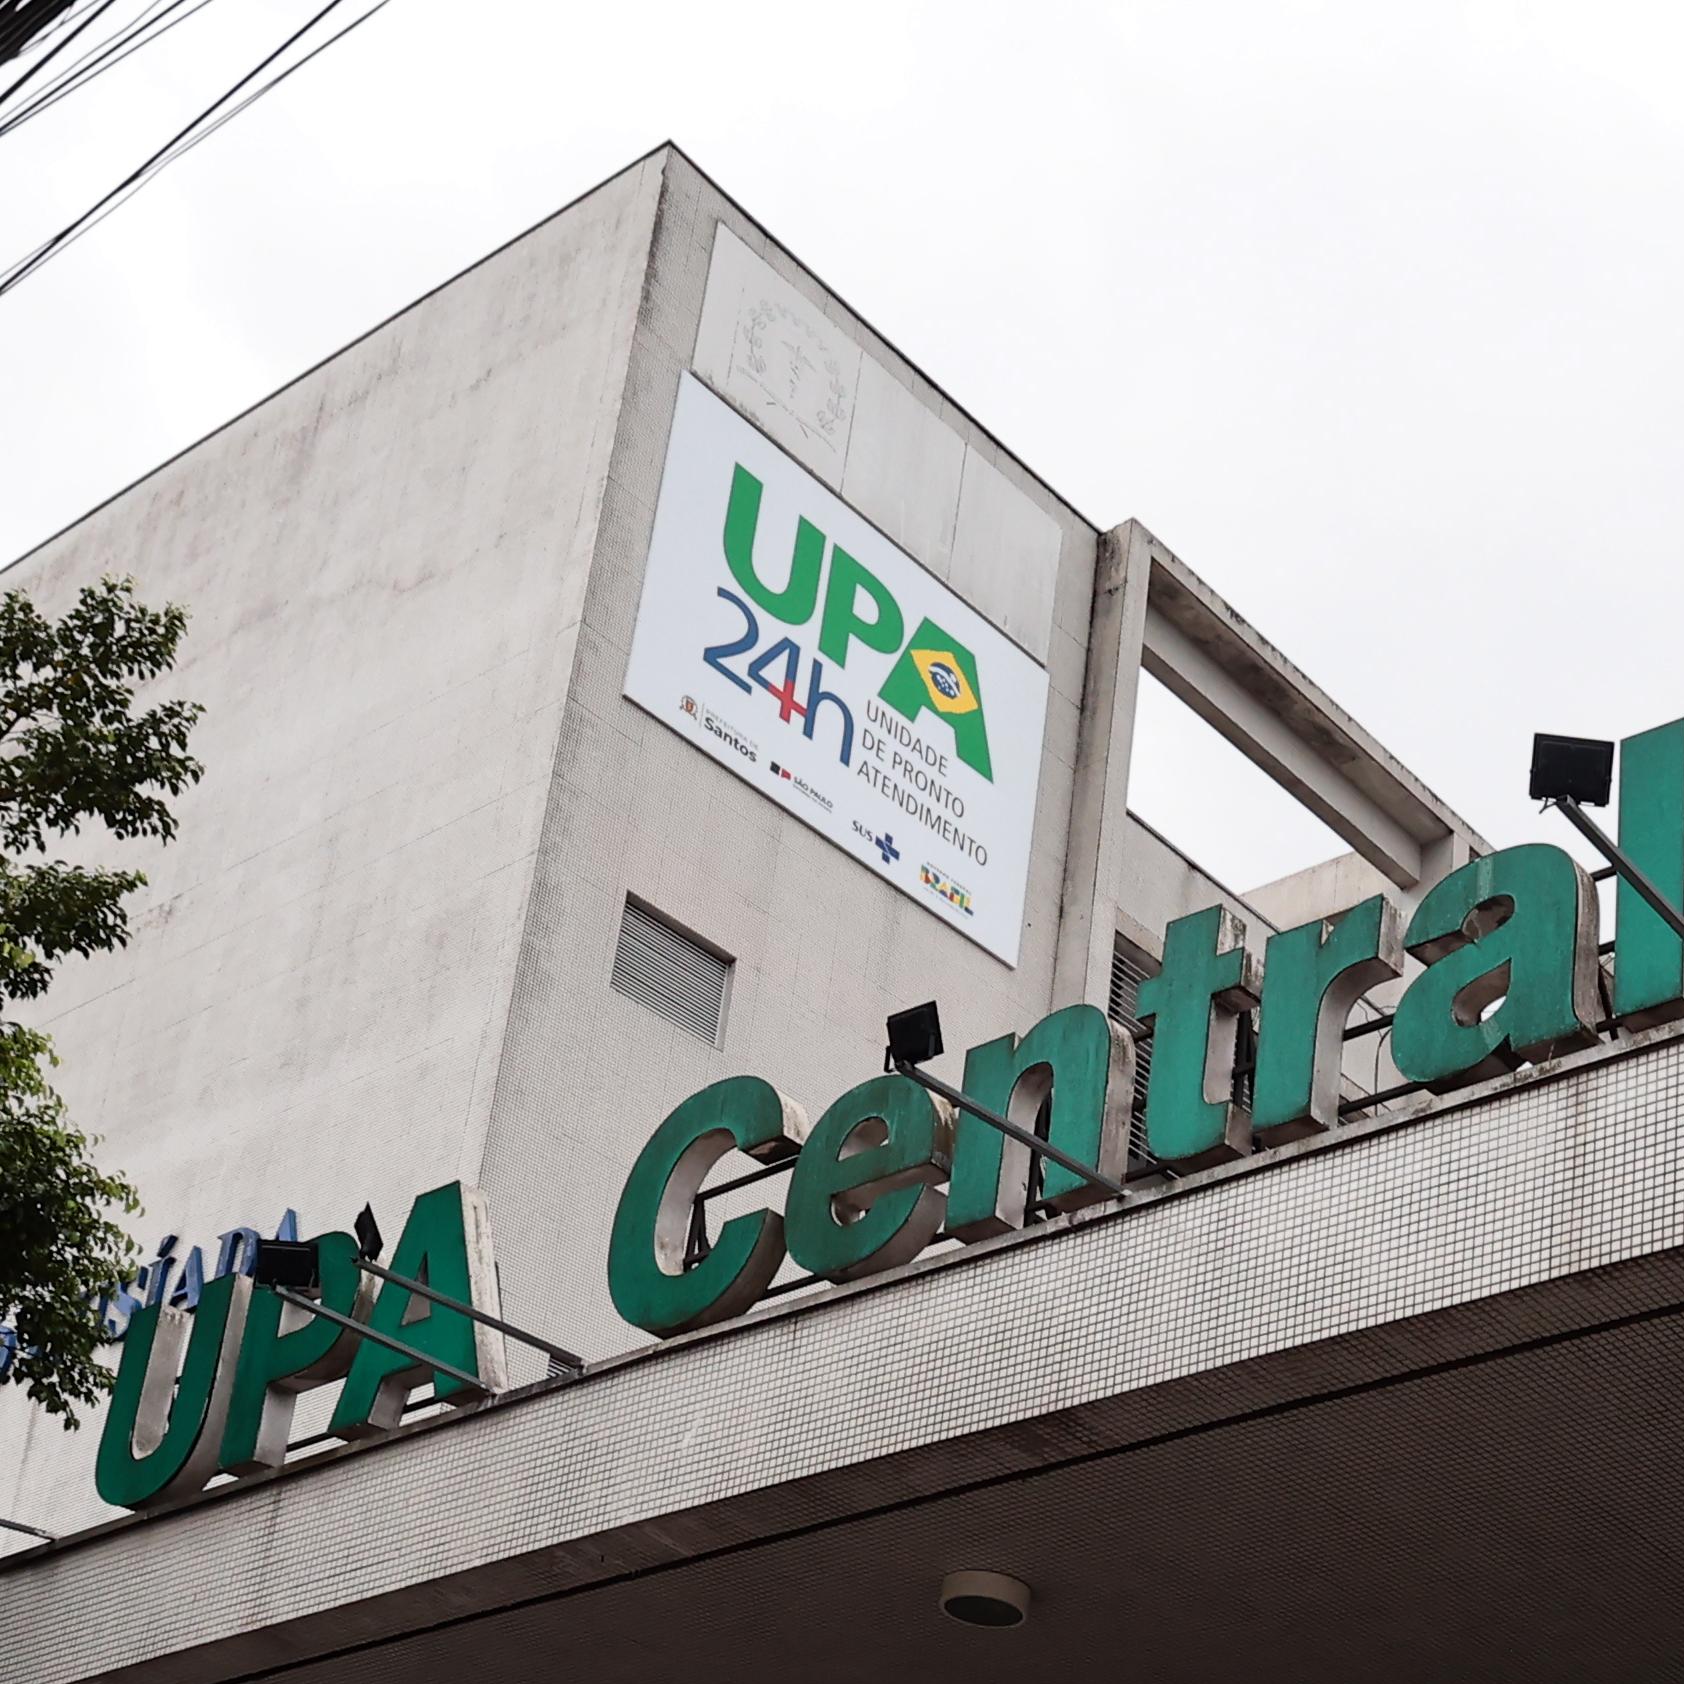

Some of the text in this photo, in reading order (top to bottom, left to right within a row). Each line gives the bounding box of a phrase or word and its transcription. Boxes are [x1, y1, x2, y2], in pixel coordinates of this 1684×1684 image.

[723, 462, 994, 784] UPA
[703, 586, 854, 767] 24h
[704, 716, 757, 762] Santos
[862, 728, 885, 762] DE
[866, 699, 948, 777] UNIDADE
[857, 760, 988, 866] ATENDIMENTO
[892, 751, 965, 818] PRONTO
[852, 819, 873, 843] SUS
[919, 864, 974, 917] BRASIL
[95, 1180, 500, 1512] UPA
